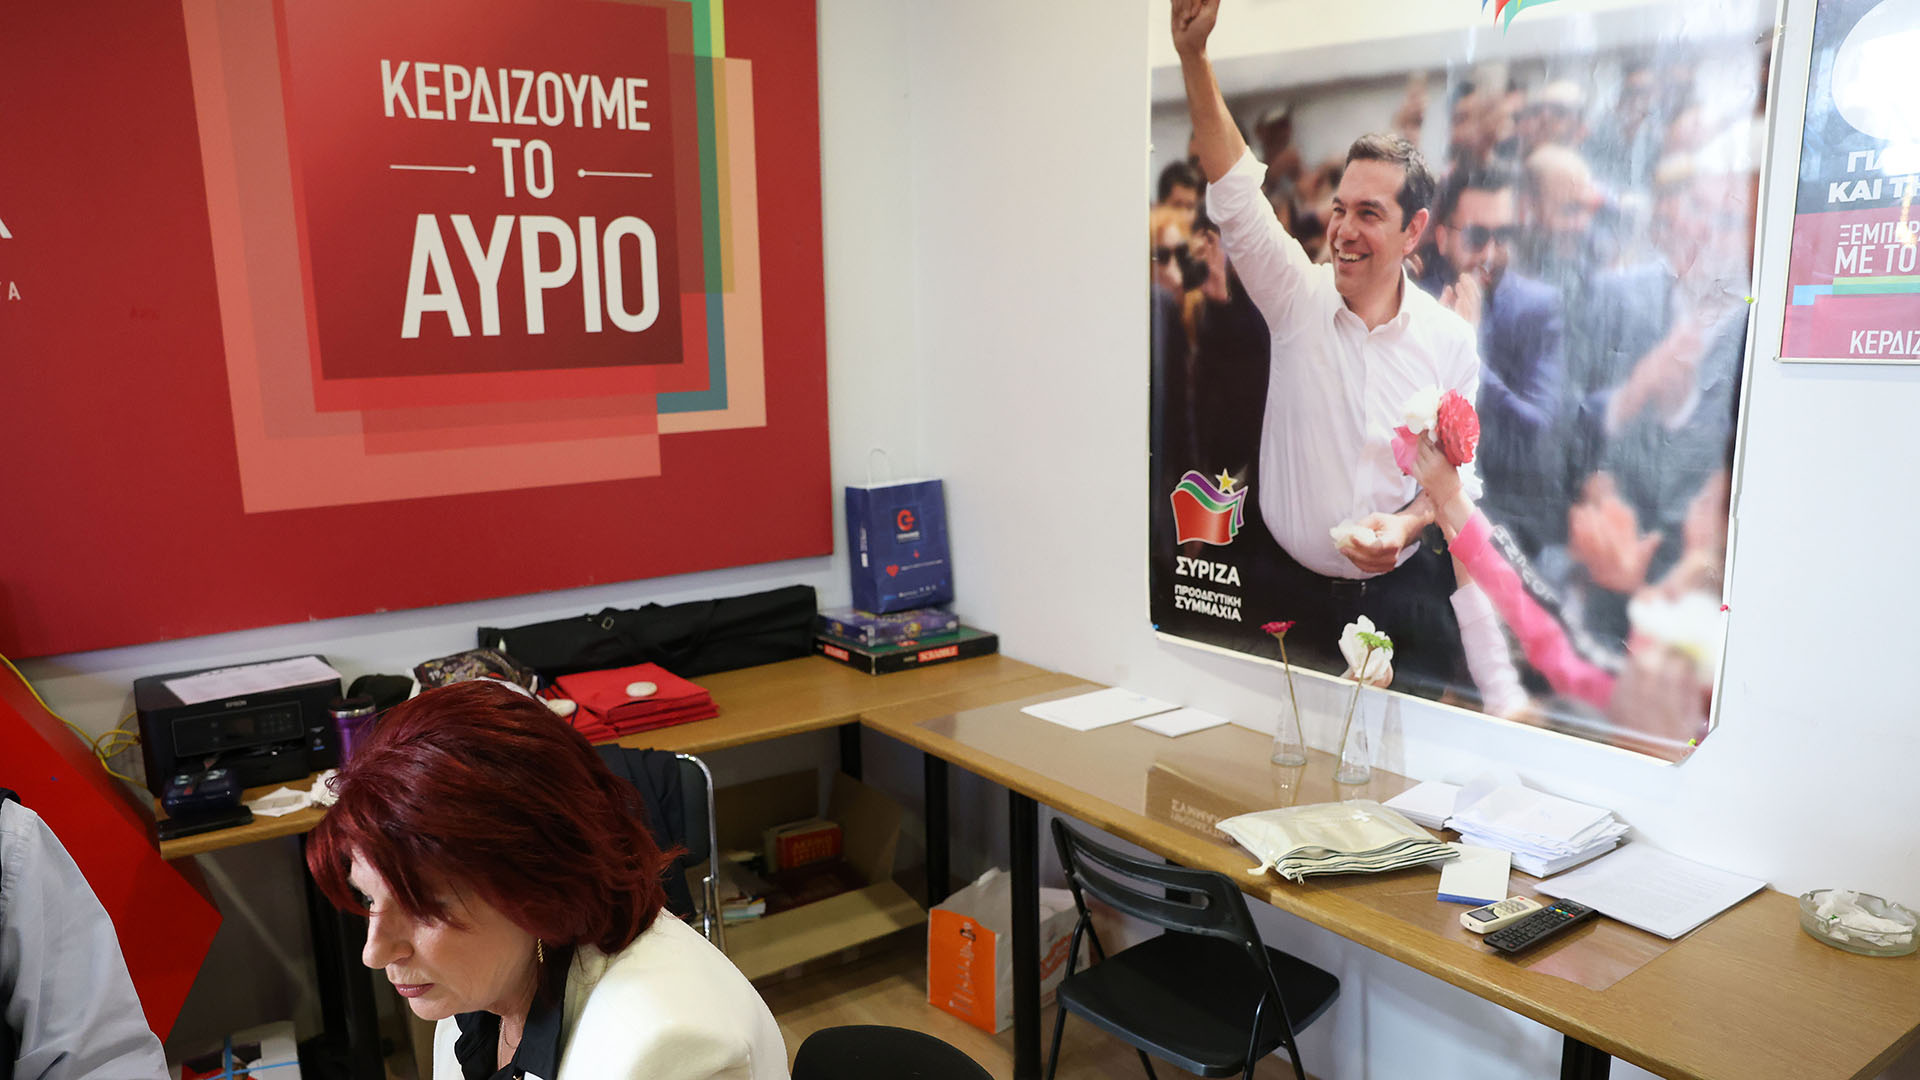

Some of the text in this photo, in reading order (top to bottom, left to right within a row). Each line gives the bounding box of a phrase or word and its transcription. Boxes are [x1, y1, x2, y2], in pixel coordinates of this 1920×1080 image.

[380, 59, 651, 131] ΚΕΡΔΙΖΟΥΜΕ
[492, 137, 555, 199] ΤΟ
[1828, 178, 1883, 204] ΚΑΙ
[1838, 221, 1920, 246] ΞΕΜΠΕΡ
[1834, 244, 1917, 275] ΜΕ ΤΟ
[401, 213, 660, 339] ΑΥΡΙΟ
[1175, 555, 1241, 587] ΣΥΡΙΖΑ
[1174, 584, 1242, 608] ΠΡΟΟΔΕΥΤΙΚΗ
[1174, 595, 1242, 622] ΣΥΜΜΑΧΙΑ
